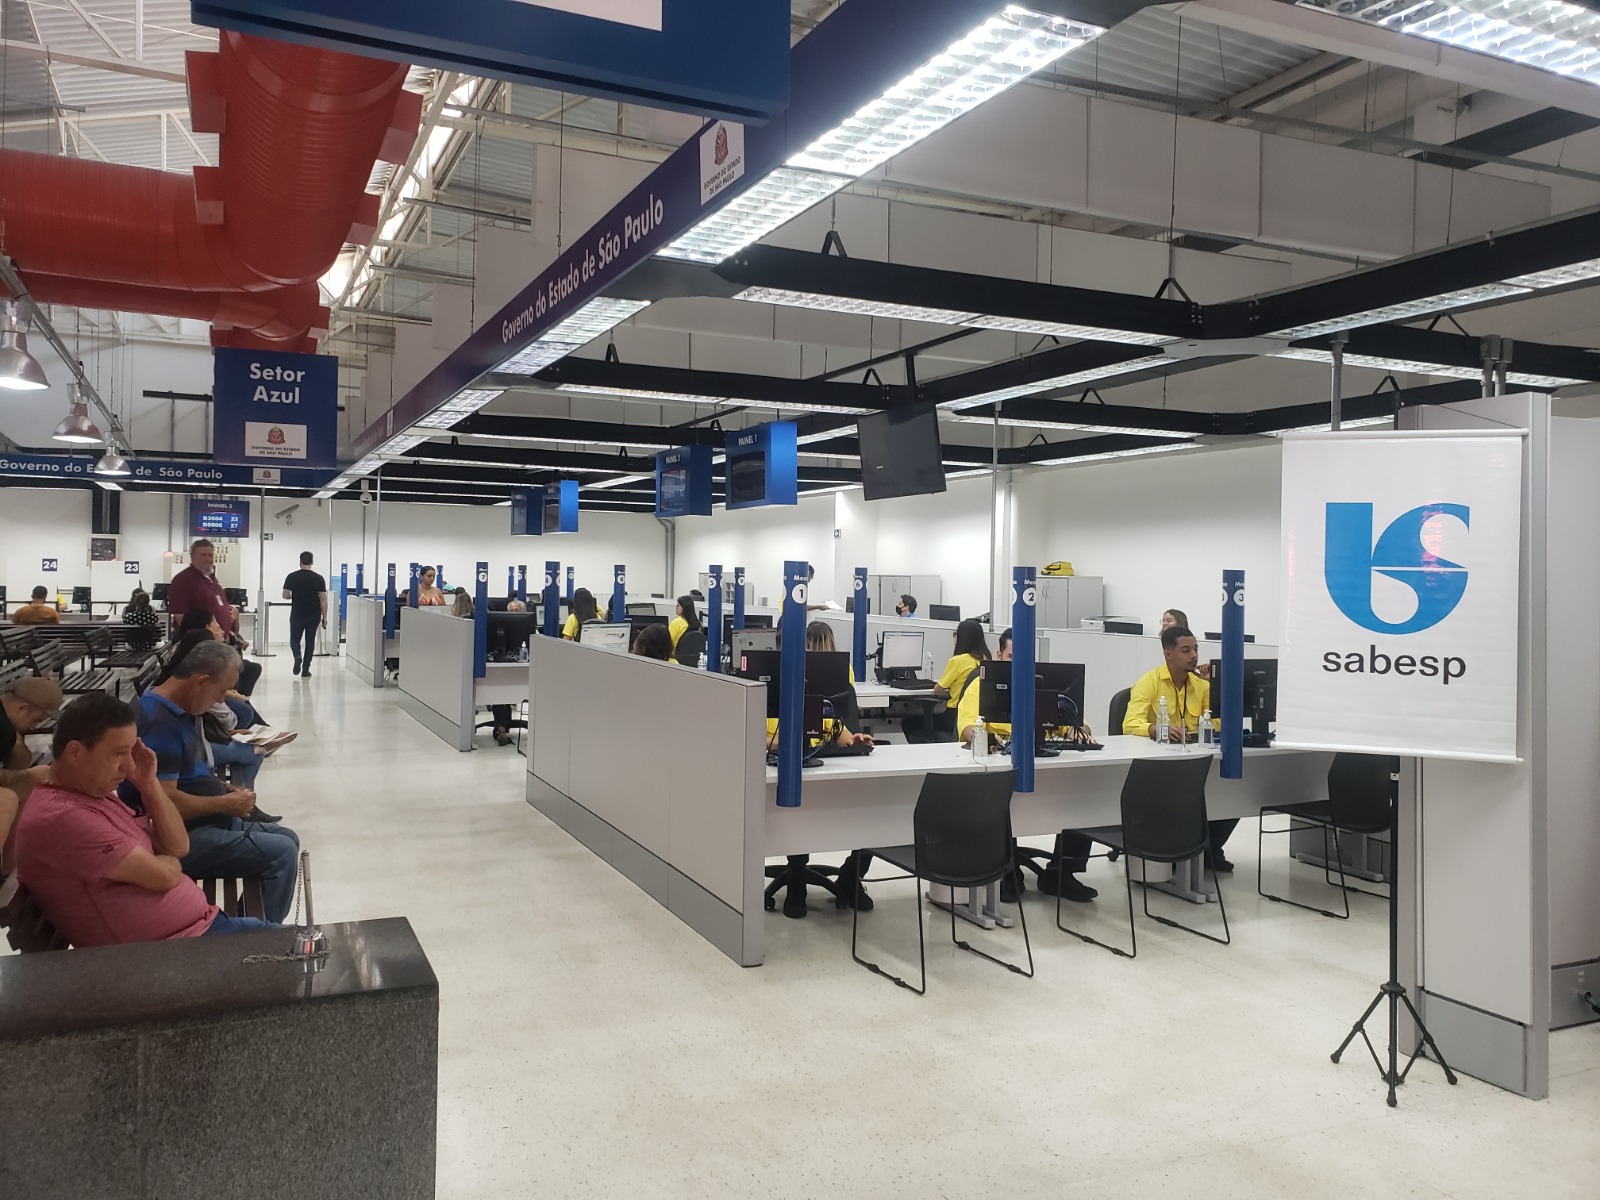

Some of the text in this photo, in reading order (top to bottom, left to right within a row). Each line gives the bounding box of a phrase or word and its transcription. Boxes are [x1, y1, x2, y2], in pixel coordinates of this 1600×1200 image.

[502, 193, 664, 344] Governo do Estado de São Paulo
[249, 362, 306, 383] Setor
[252, 385, 300, 404] Azul
[738, 435, 754, 446] PAINEL
[0, 459, 60, 472] Governo
[64, 462, 82, 473] do
[135, 466, 153, 476] de
[159, 467, 184, 478] São
[187, 468, 223, 480] Paulo
[43, 561, 57, 569] 24
[125, 563, 139, 572] 23
[799, 588, 804, 598] 1
[1028, 592, 1035, 602] 2
[1238, 593, 1244, 602] 3
[1321, 644, 1467, 685] sabesp
